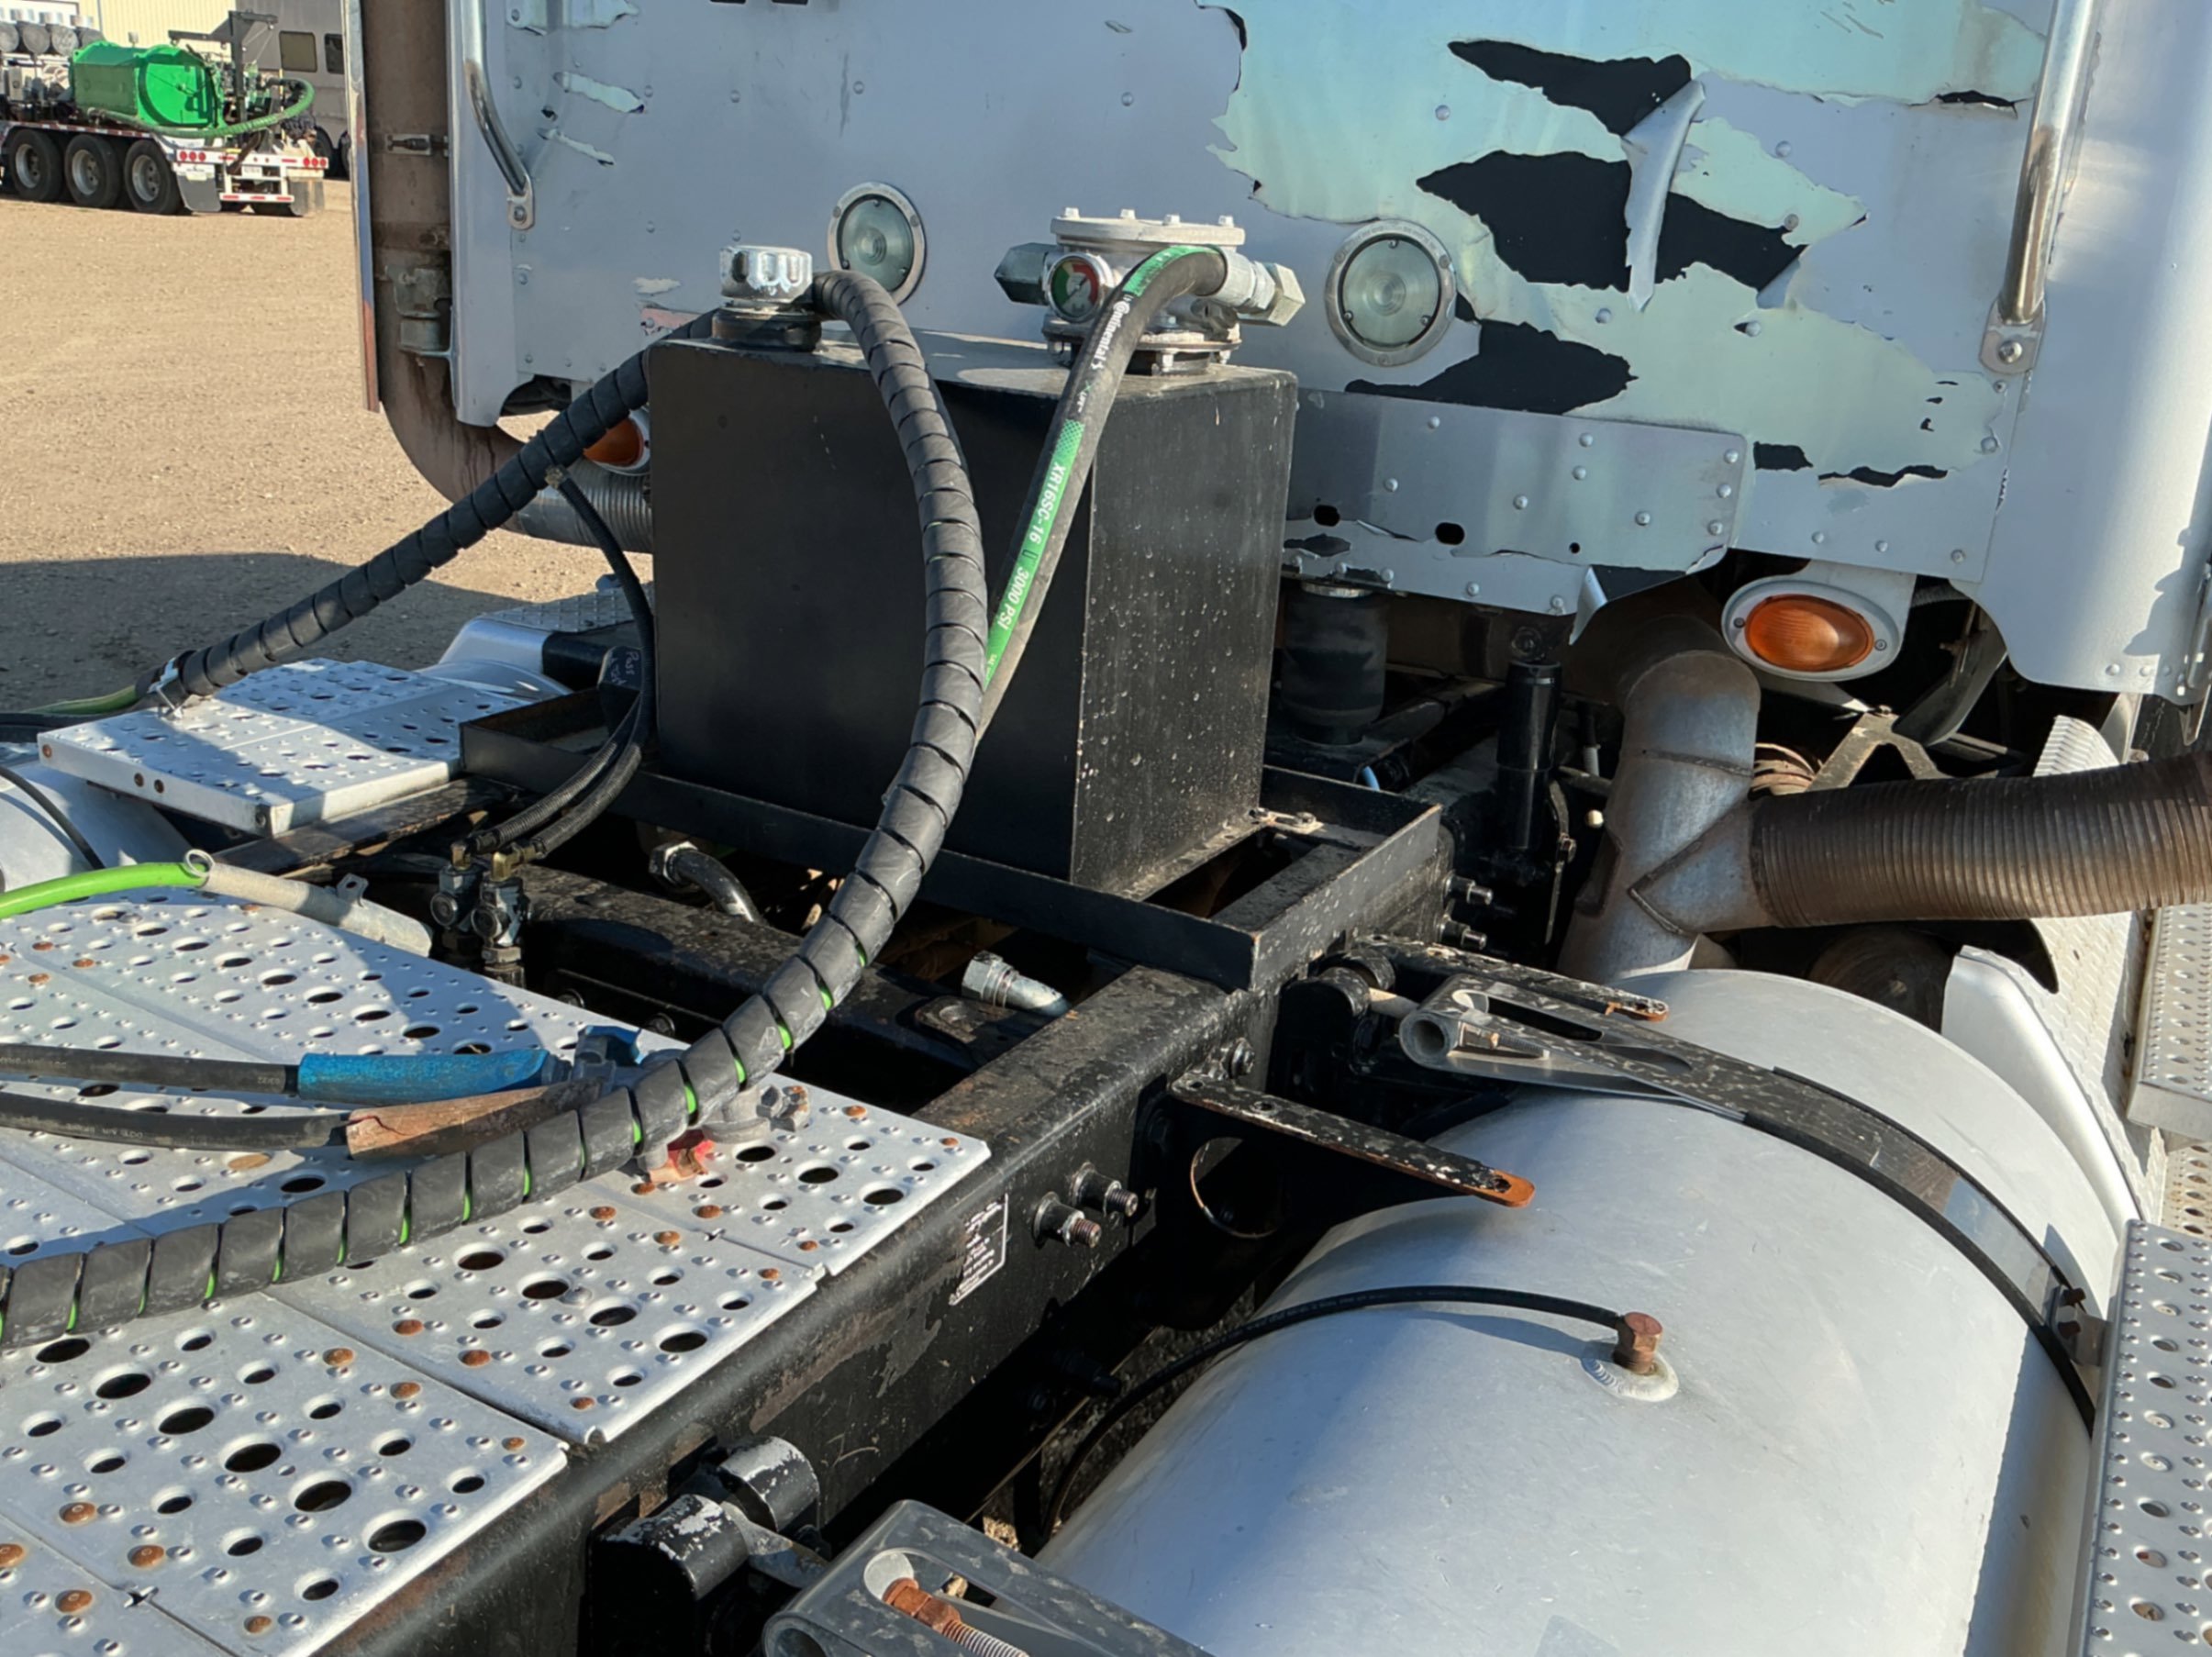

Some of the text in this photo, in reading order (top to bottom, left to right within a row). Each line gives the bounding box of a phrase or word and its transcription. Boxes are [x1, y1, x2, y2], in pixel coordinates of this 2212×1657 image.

[1094, 300, 1130, 361] Continental
[1028, 462, 1066, 545] XR16SC-16
[996, 566, 1029, 630] 3000 PSI
